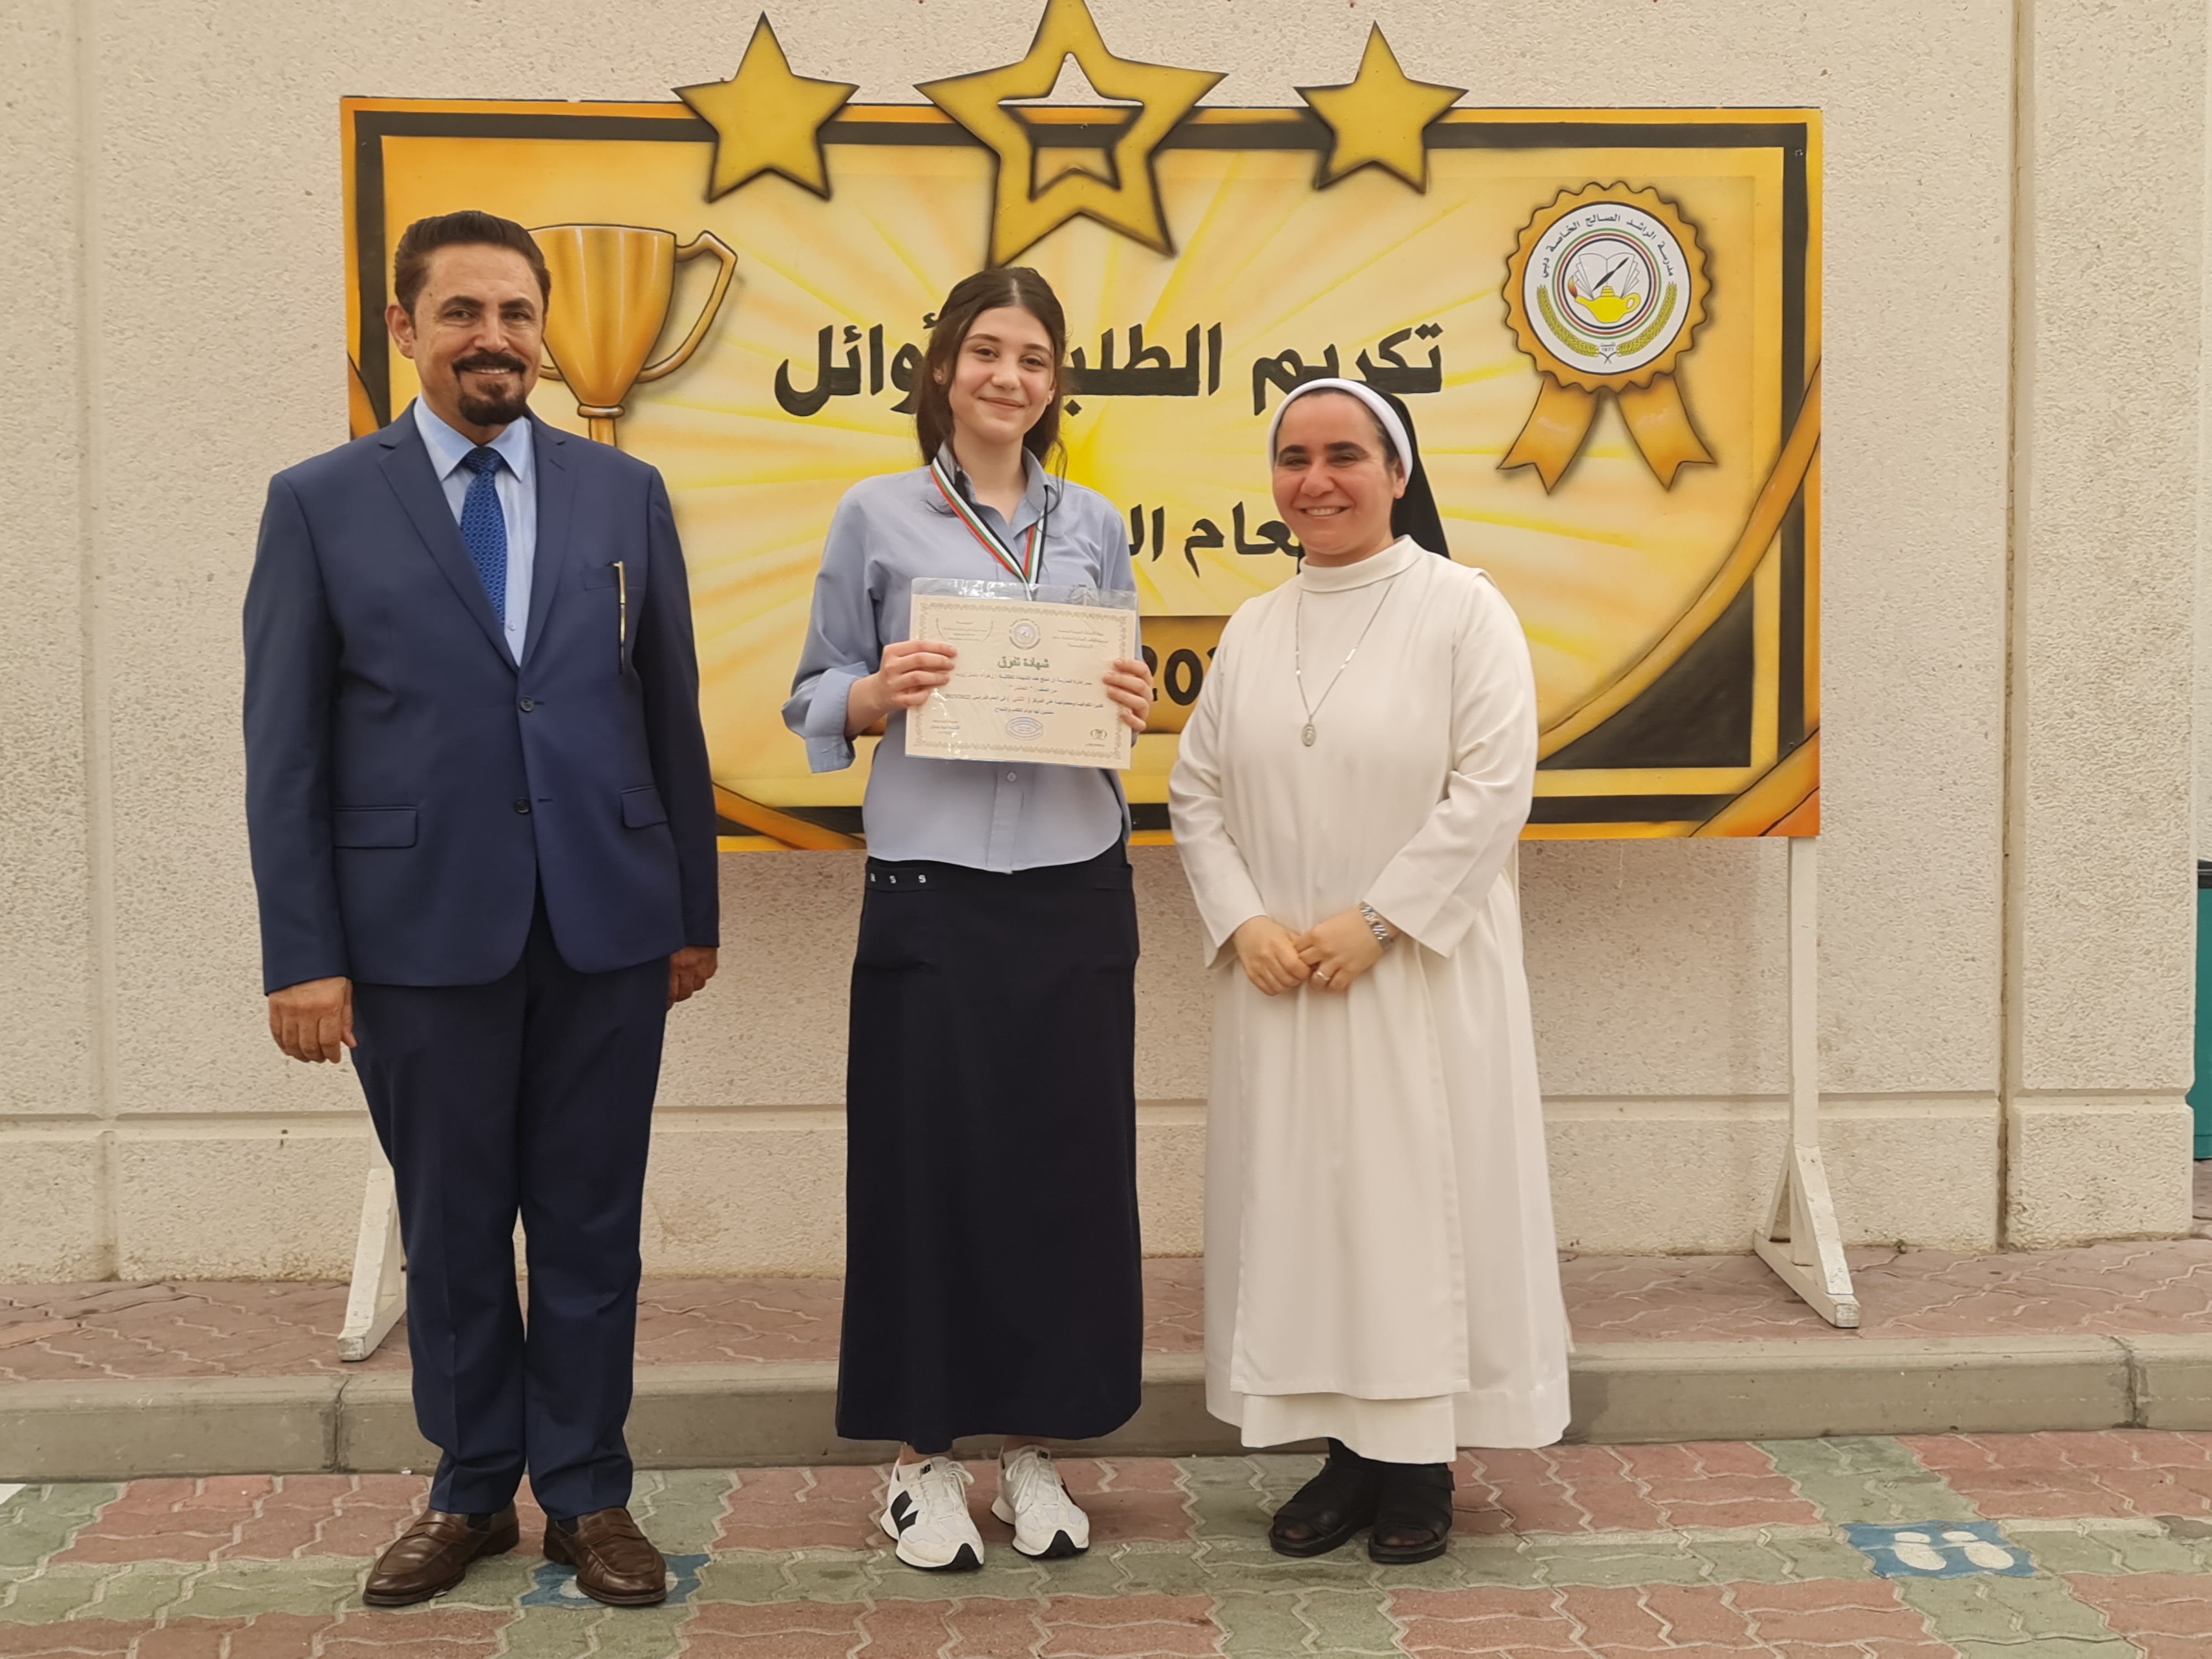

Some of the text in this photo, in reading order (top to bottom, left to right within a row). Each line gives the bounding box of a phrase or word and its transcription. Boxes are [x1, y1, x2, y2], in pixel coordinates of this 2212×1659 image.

[1585, 213, 1621, 227] الصالح
[1546, 221, 1580, 252] الخاصة
[1062, 319, 1222, 416] الطلب
